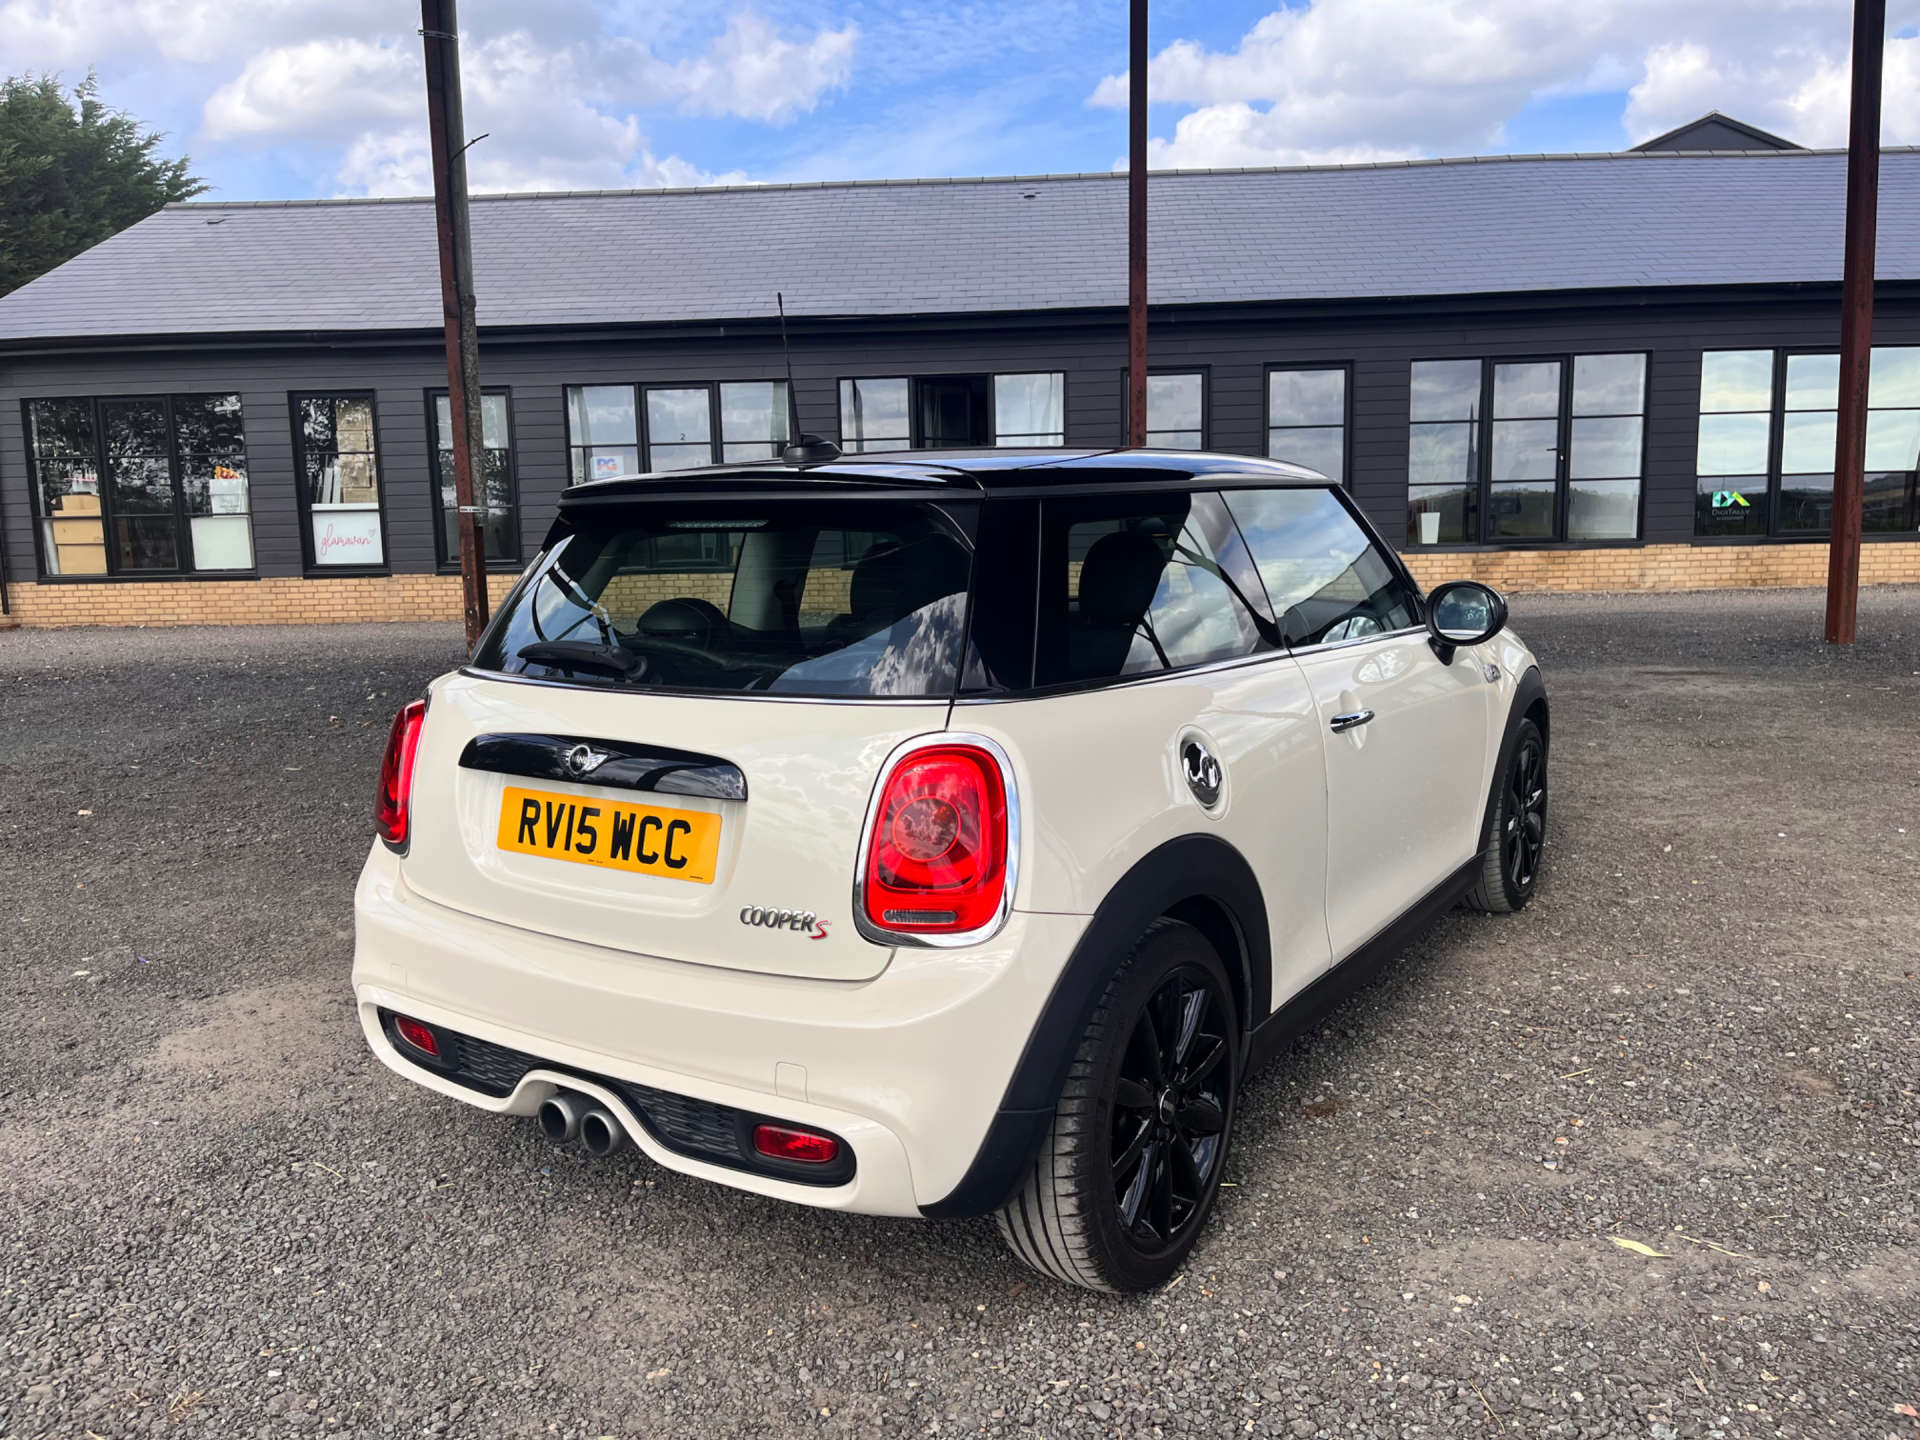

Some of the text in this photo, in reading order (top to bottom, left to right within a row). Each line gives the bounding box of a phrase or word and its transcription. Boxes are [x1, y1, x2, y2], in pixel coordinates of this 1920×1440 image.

[517, 798, 692, 869] RV15 WCC
[740, 905, 832, 940] COOPER S
